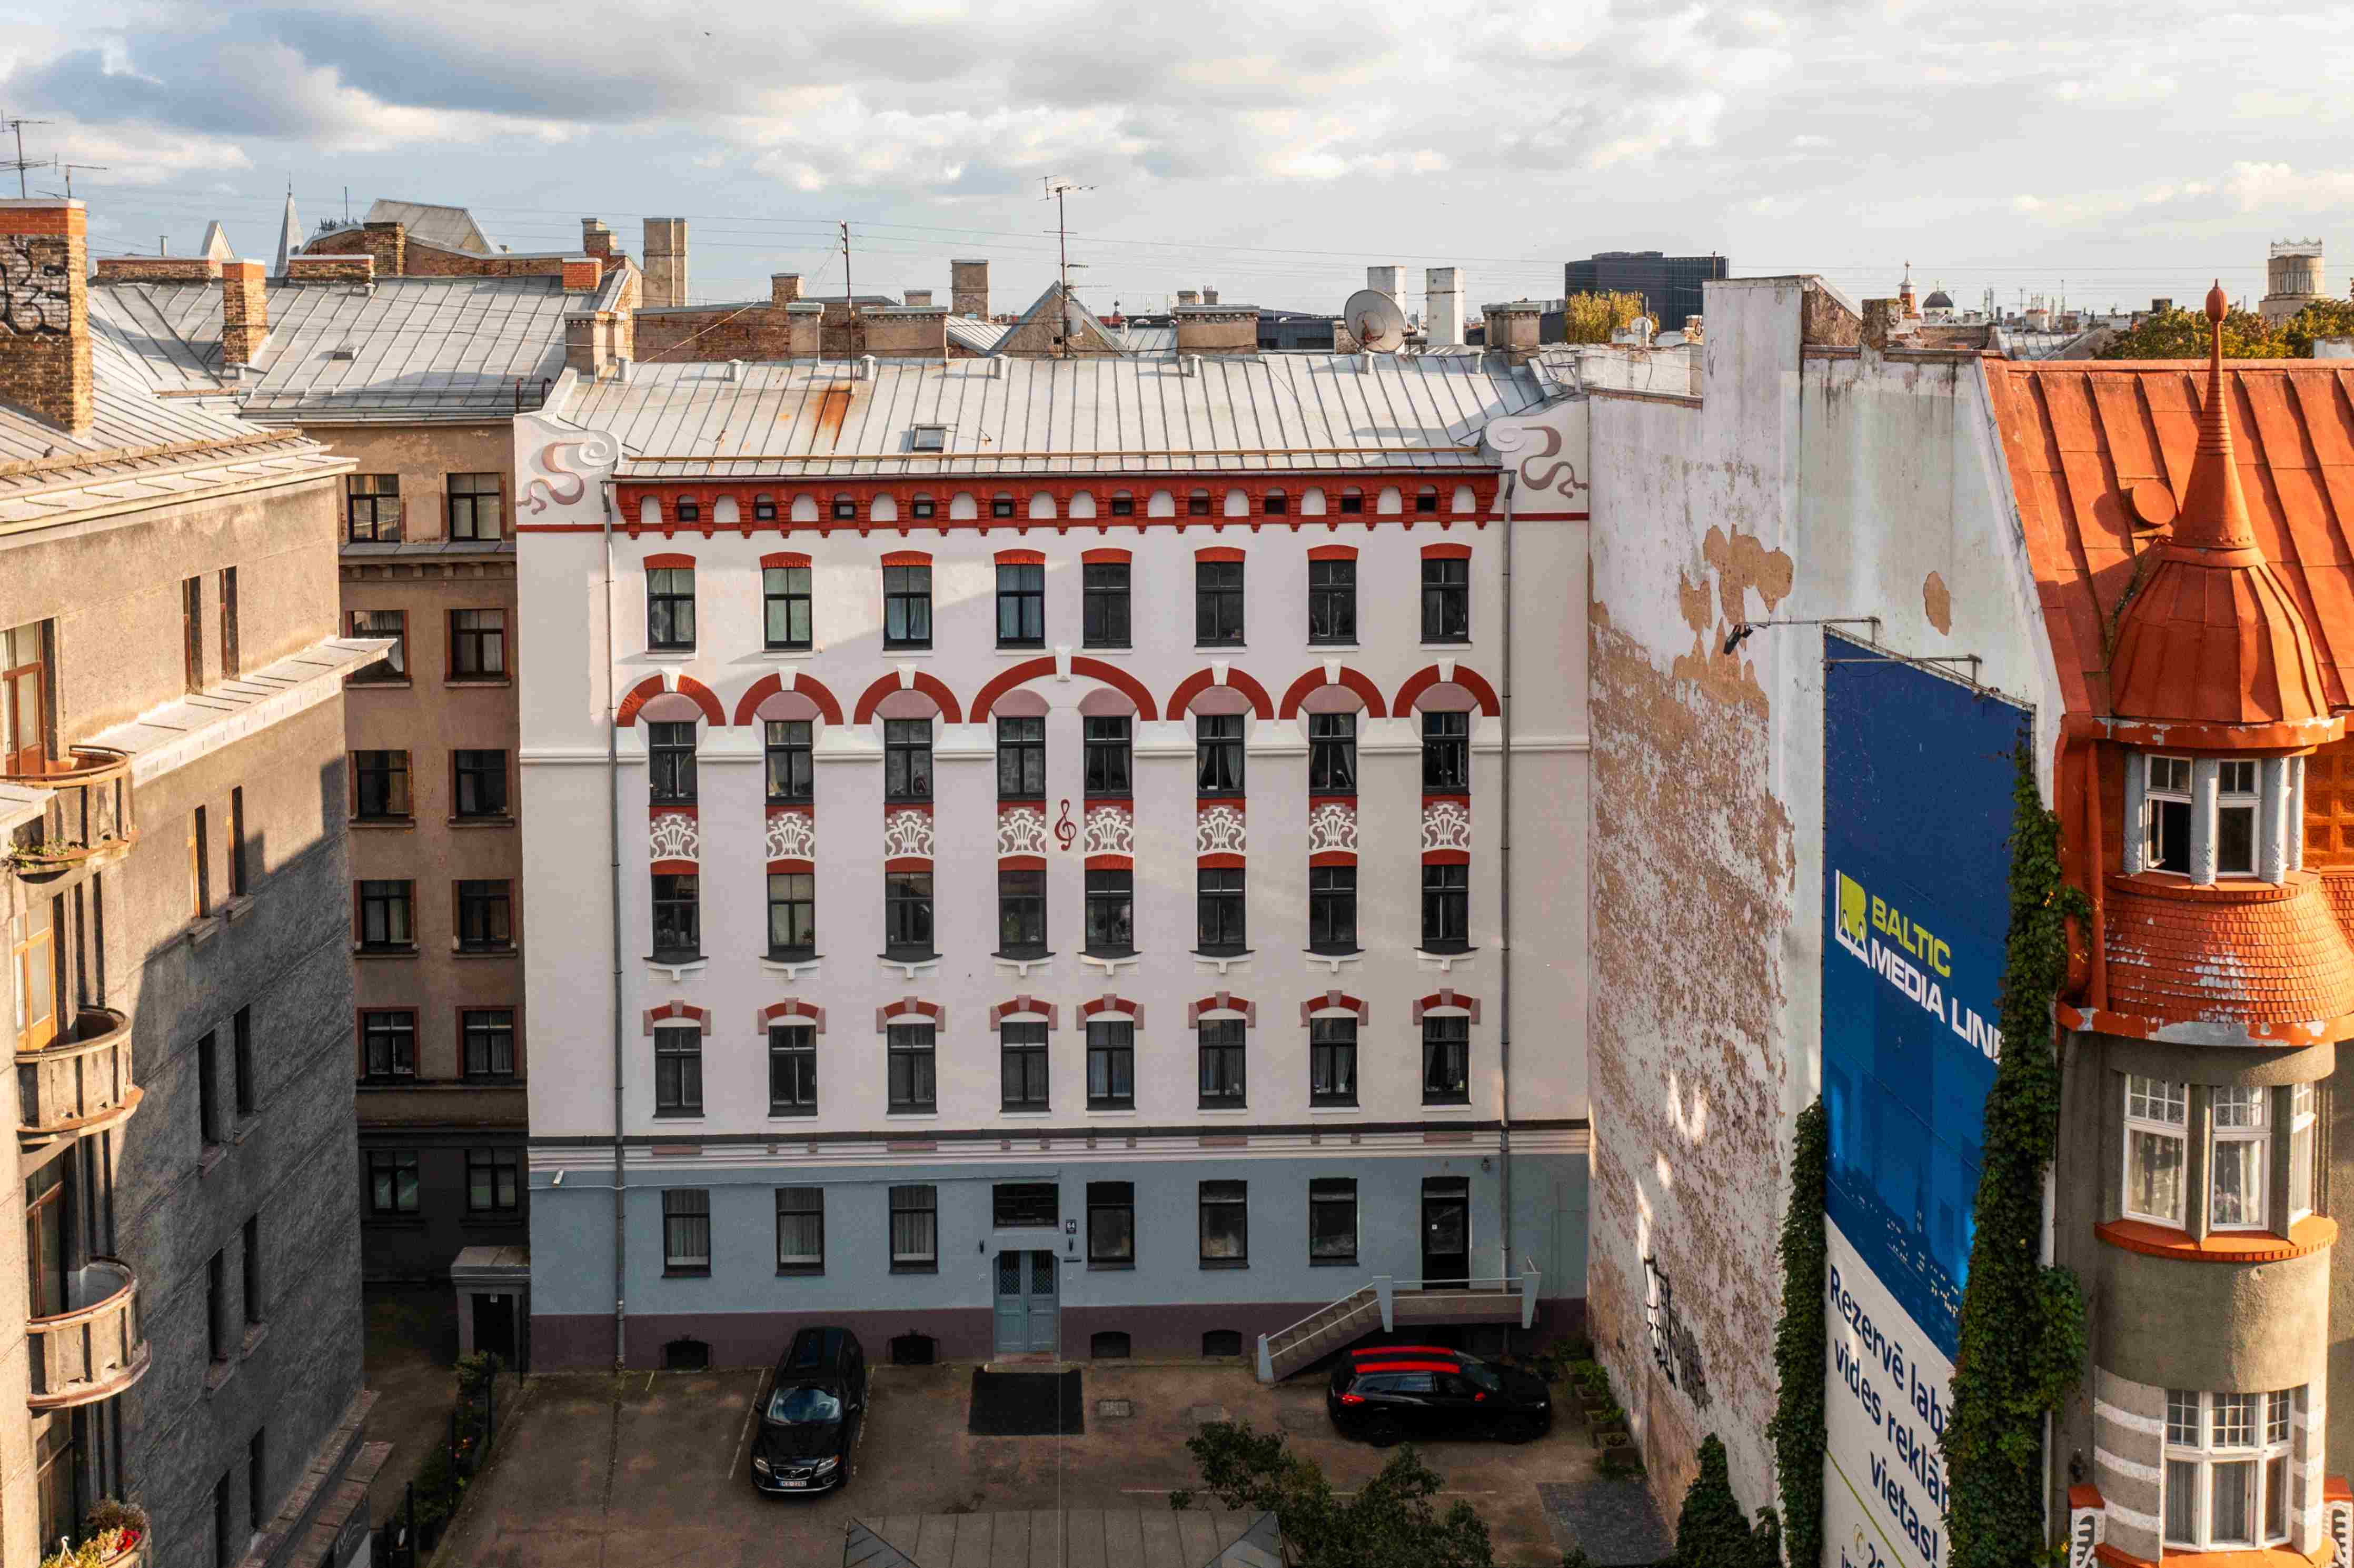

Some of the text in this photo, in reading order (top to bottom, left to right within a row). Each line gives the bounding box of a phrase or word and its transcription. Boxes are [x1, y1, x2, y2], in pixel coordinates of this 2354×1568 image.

[1871, 937, 1946, 1024] MEDIA
[1872, 895, 1951, 978] BALTIC
[1830, 1263, 1951, 1437] Rezervē lab
[1834, 1337, 1881, 1426] vides
